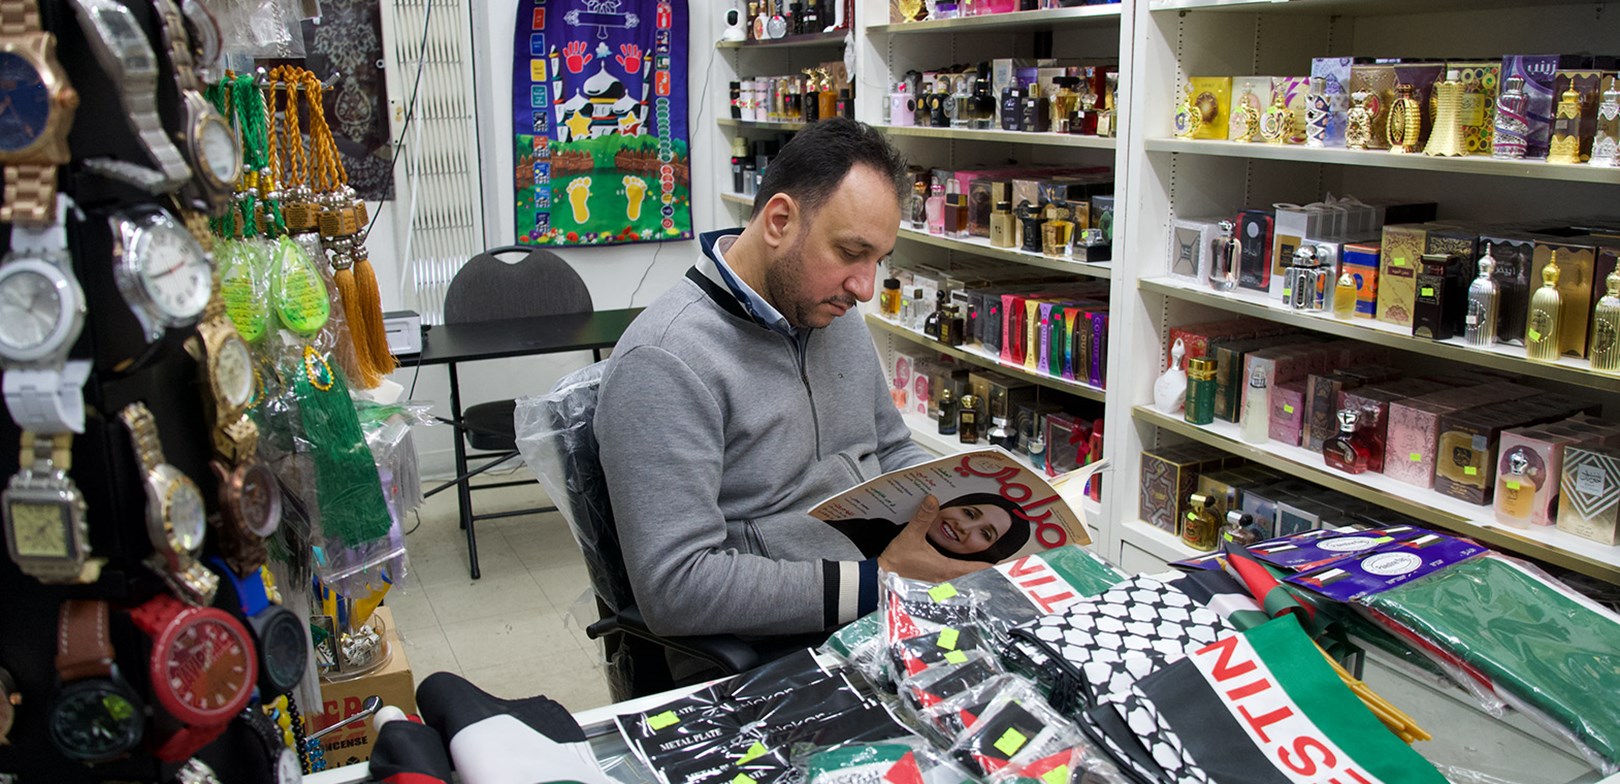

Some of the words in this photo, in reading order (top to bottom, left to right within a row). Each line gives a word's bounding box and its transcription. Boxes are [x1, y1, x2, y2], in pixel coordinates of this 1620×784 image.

[322, 736, 368, 752] NCENSE
[660, 734, 694, 751] METAL
[692, 728, 723, 745] PLATE
